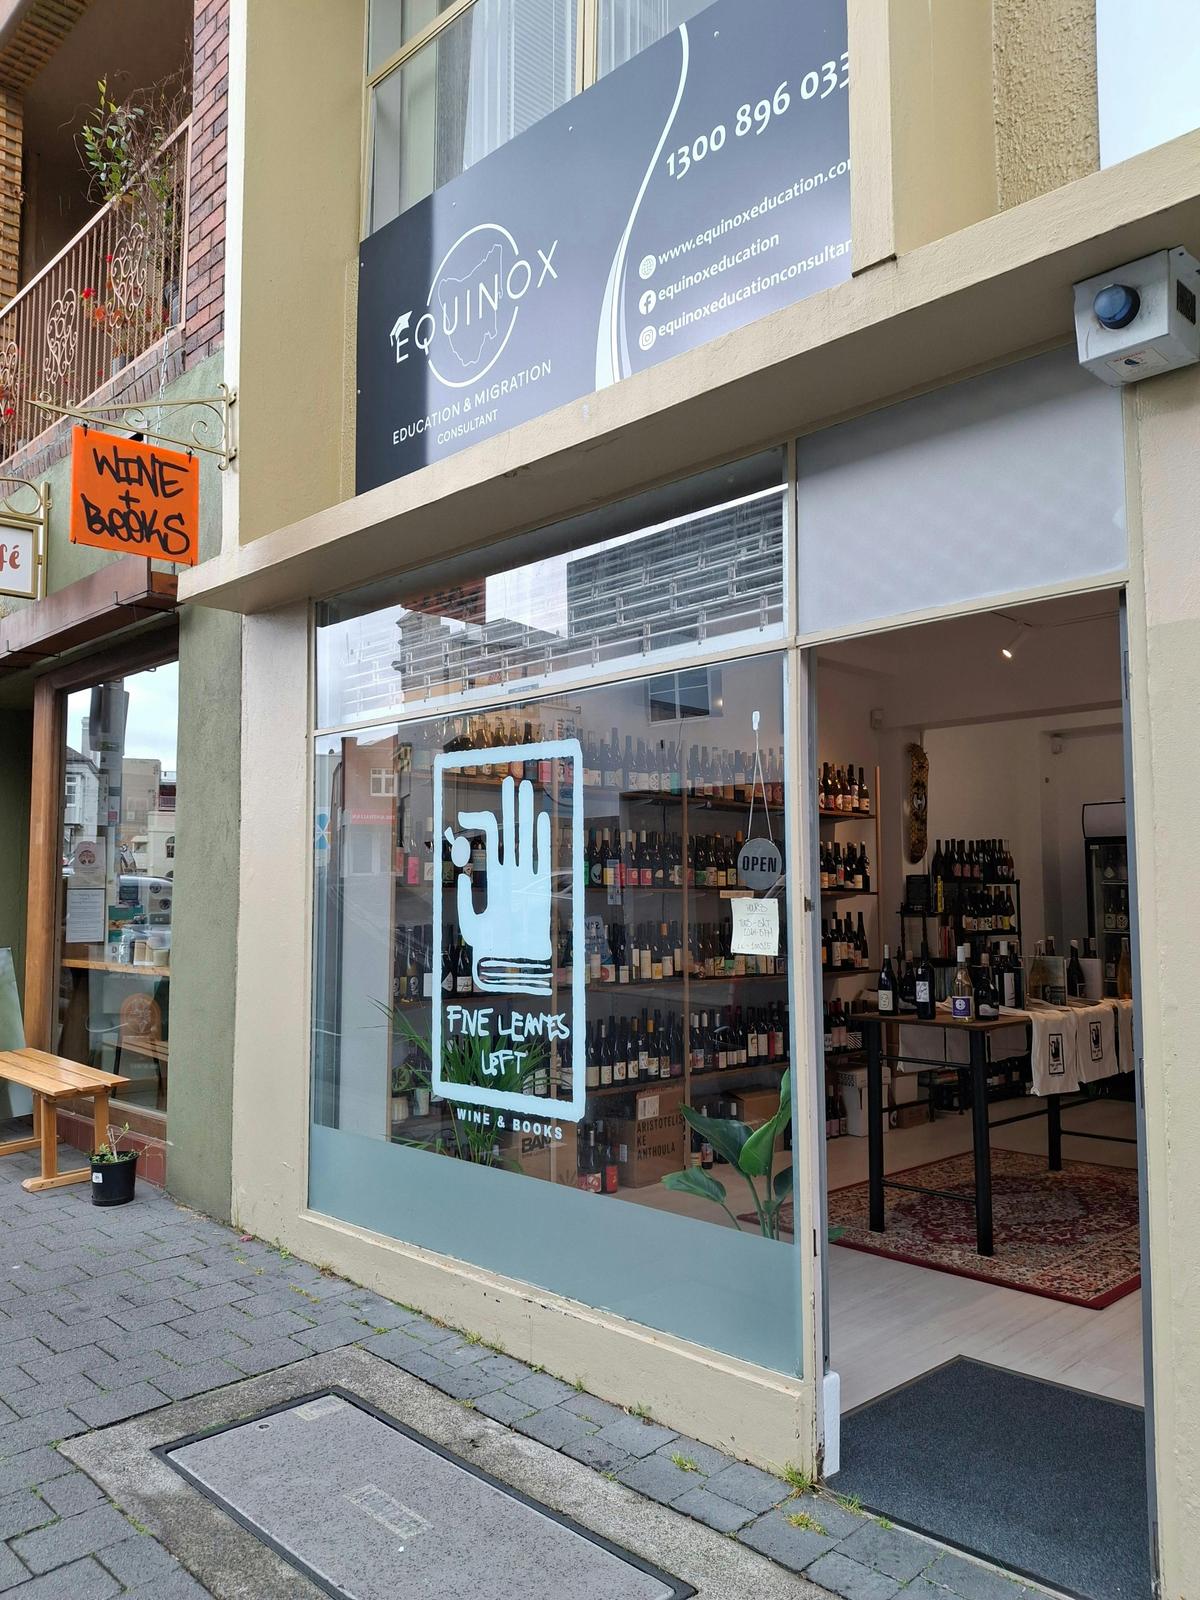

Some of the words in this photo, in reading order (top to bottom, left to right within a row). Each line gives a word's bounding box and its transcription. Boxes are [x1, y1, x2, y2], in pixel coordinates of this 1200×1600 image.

[666, 125, 726, 180] 1300
[735, 81, 791, 136] 896
[658, 158, 850, 265] www.equinoxeducation.co
[658, 233, 780, 300] equinoxeducation
[393, 239, 559, 364] EQUINOX
[393, 404, 460, 446] EDUCATION
[463, 397, 472, 413] &
[474, 359, 552, 407] MIGRATION
[437, 408, 499, 446] CONSULTANT
[92, 445, 190, 499] WINE
[80, 493, 191, 556] BOOKS
[742, 855, 777, 873] OPEN
[446, 1005, 494, 1037] FIVE
[498, 1011, 571, 1042] LEAVES
[481, 1049, 529, 1077] LEFT
[456, 1107, 490, 1126] WINE
[496, 1115, 506, 1129] &
[512, 1118, 564, 1140] BOOKS
